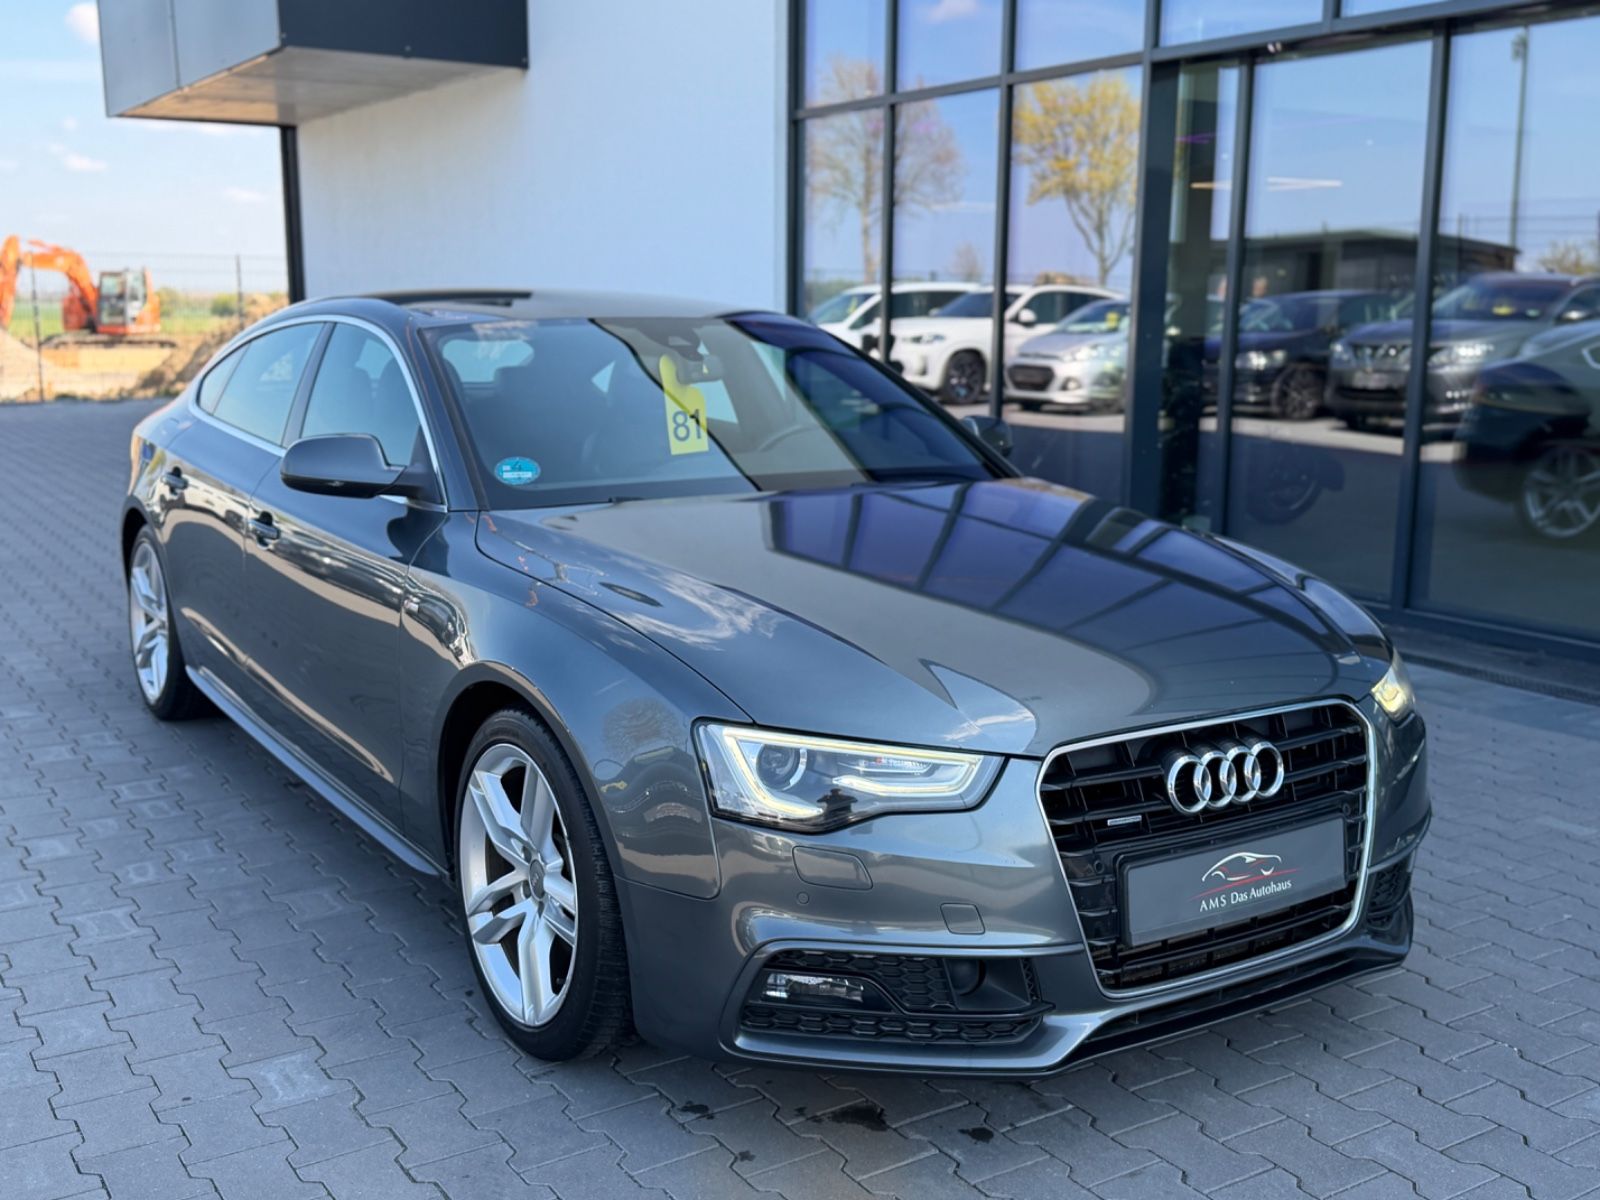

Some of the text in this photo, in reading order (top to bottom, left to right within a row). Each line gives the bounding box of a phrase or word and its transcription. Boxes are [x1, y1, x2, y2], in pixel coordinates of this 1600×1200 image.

[672, 408, 702, 442] 81
[1230, 891, 1248, 905] Das
[1249, 879, 1292, 899] Autohaus
